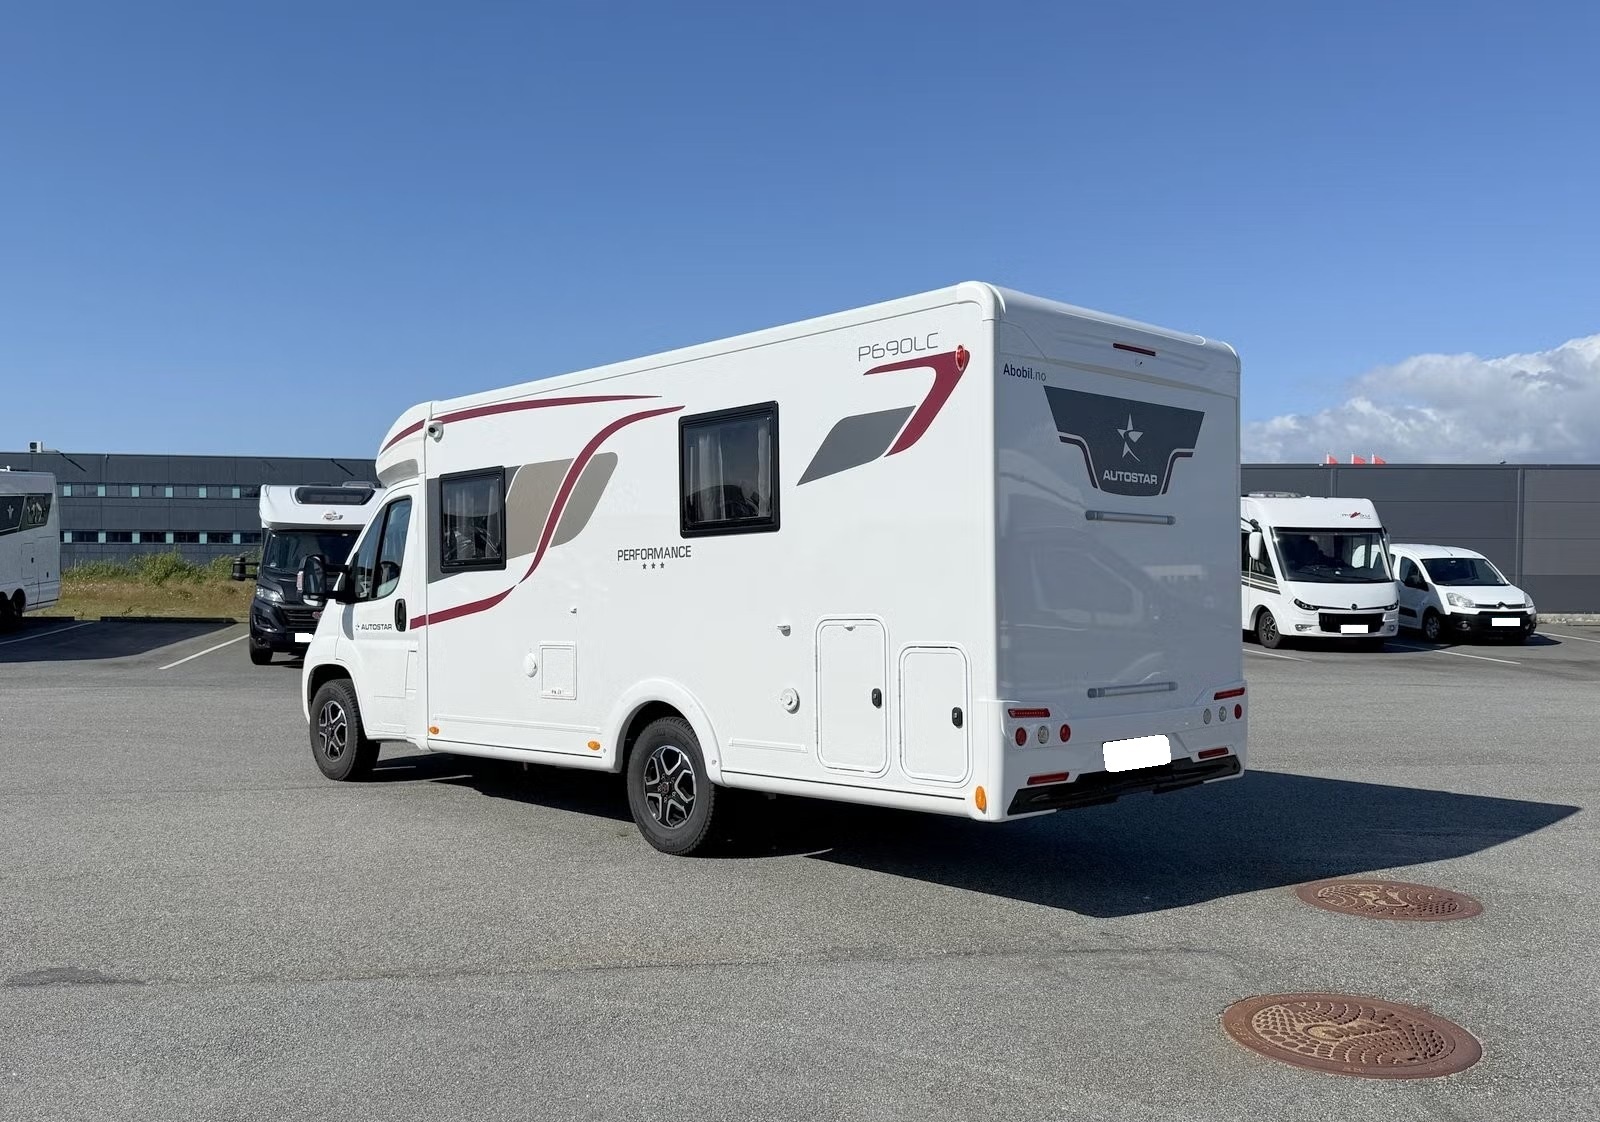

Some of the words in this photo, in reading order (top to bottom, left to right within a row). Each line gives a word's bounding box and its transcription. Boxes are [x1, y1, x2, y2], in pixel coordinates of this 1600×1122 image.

[858, 332, 939, 362] P690LC
[1003, 363, 1047, 382] Abobil.no
[1103, 469, 1158, 485] AUTOSTAR
[617, 545, 692, 561] PERFORMANCE
[361, 623, 393, 631] AUTOSTAR
